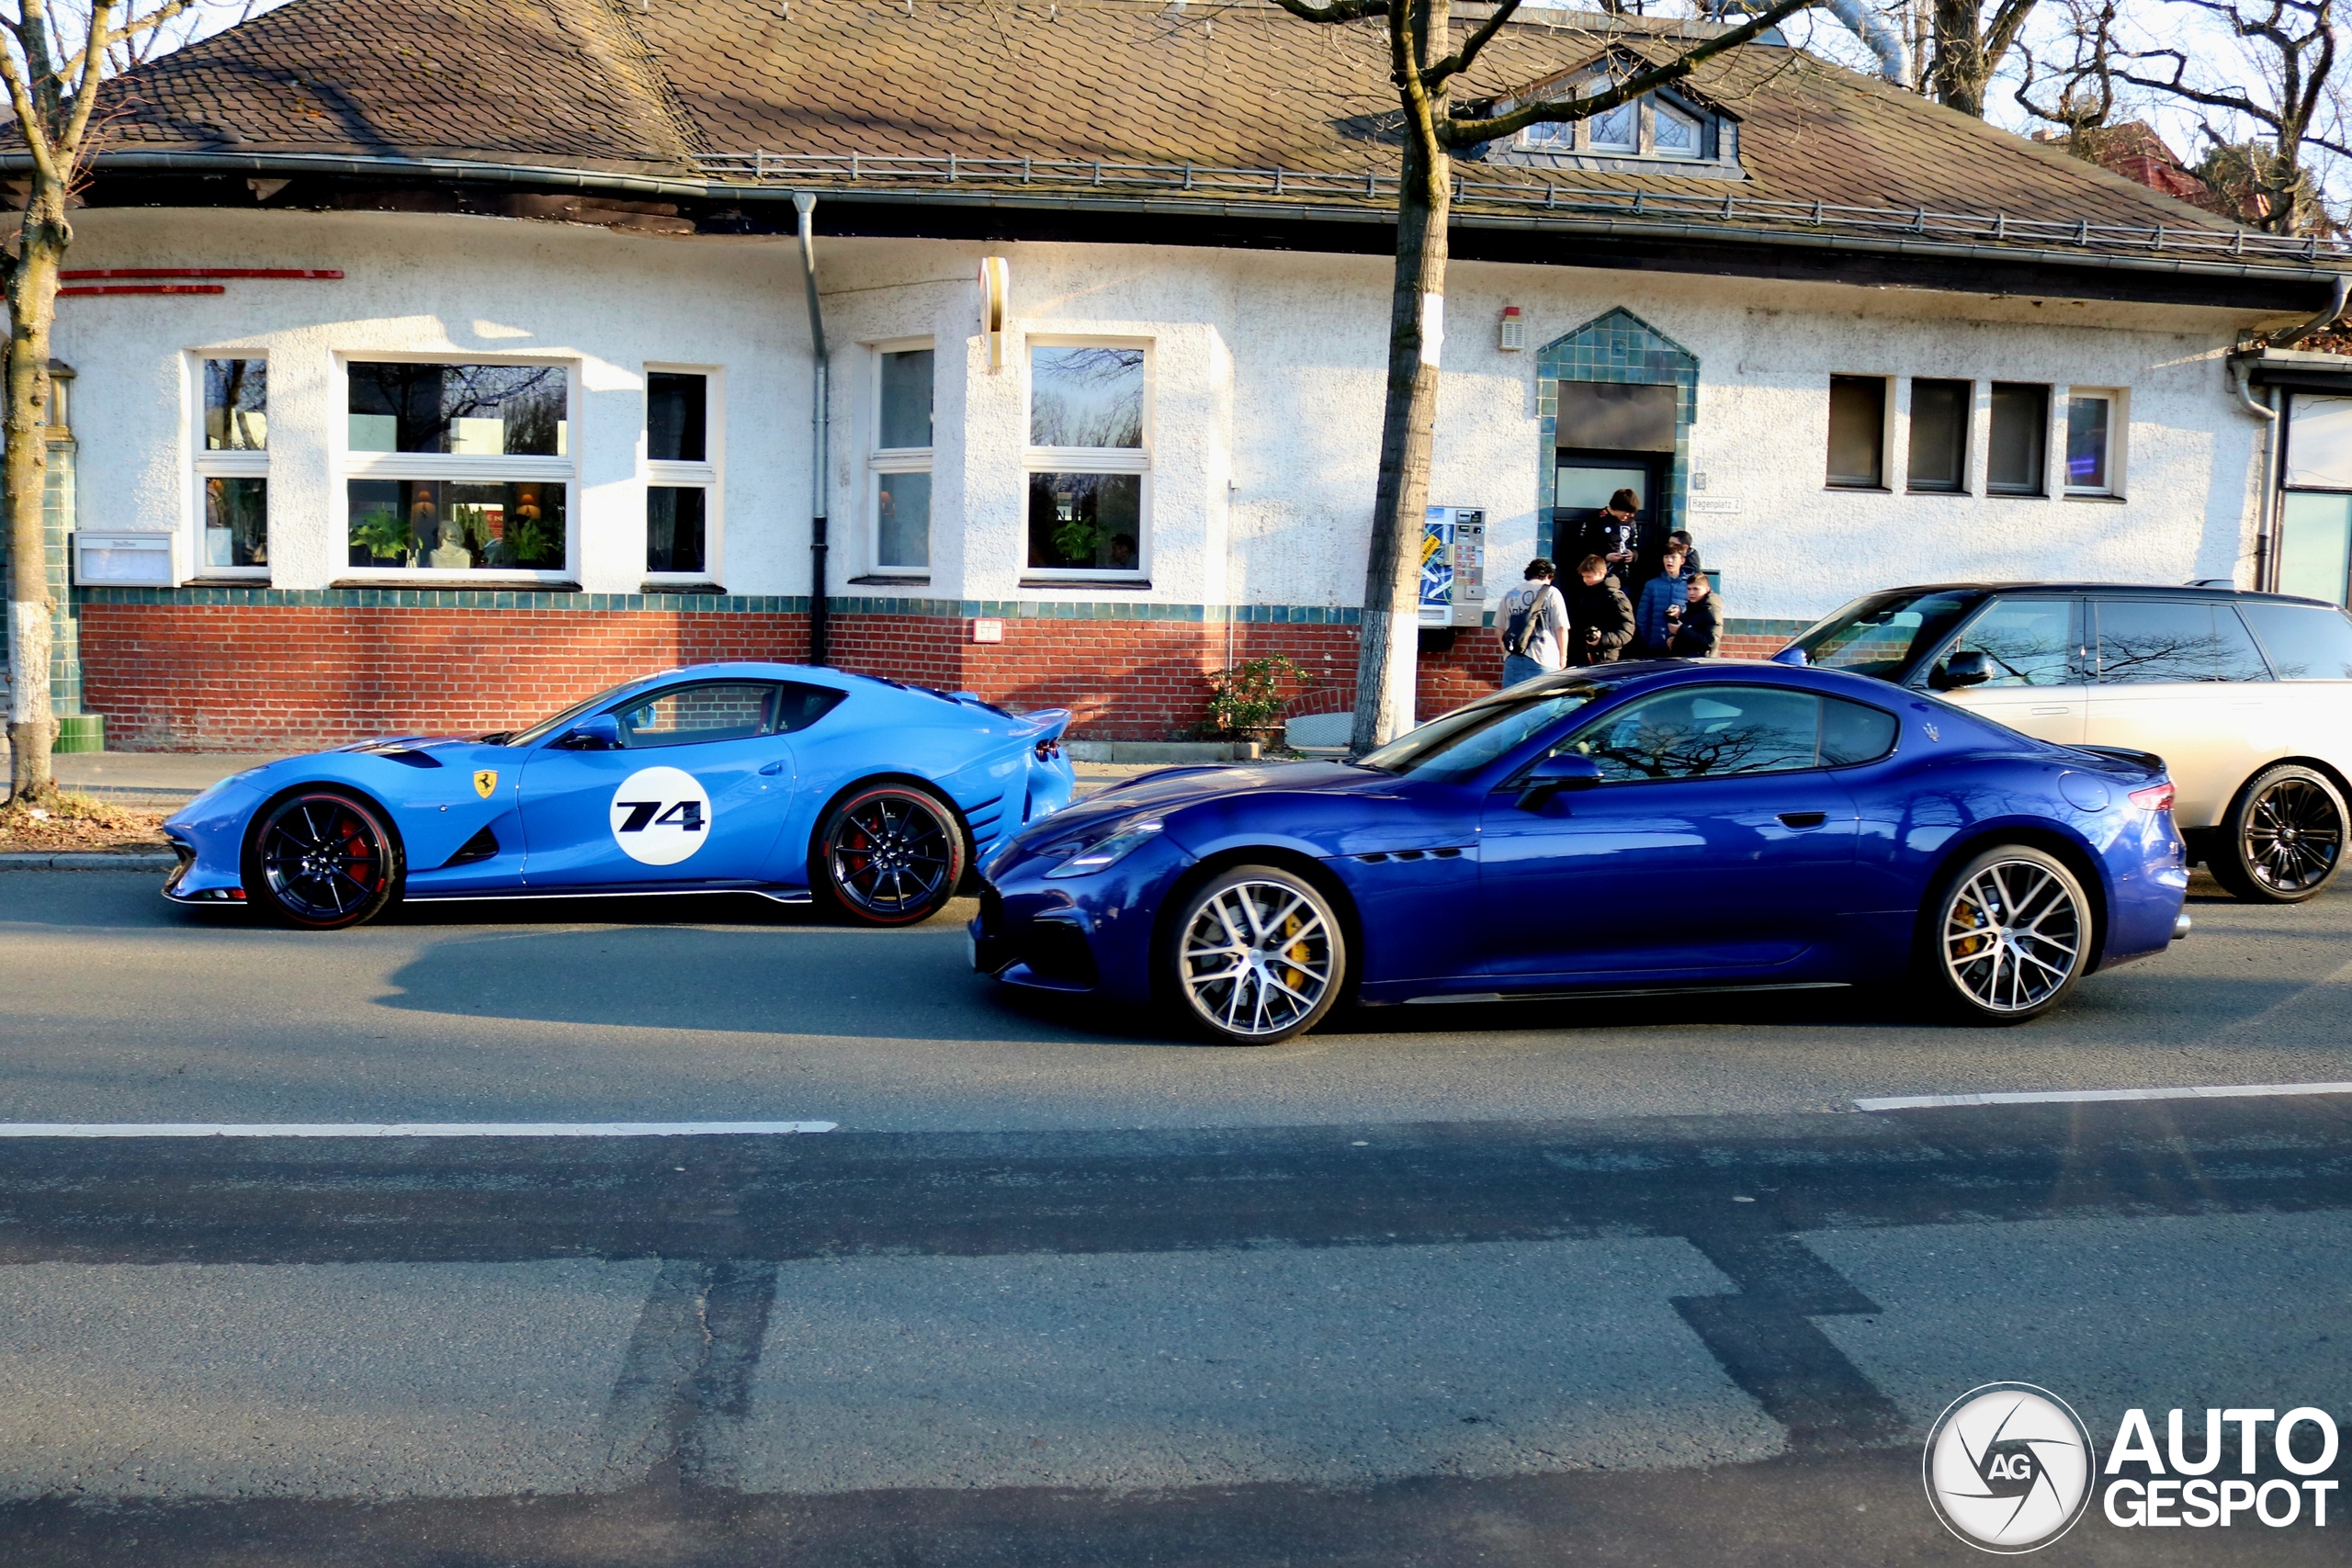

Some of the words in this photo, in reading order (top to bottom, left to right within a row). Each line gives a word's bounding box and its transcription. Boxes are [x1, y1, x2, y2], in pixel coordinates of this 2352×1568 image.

[1692, 499, 1732, 510] Hagenplatz
[1735, 499, 1739, 509] 2
[616, 801, 706, 832] 74
